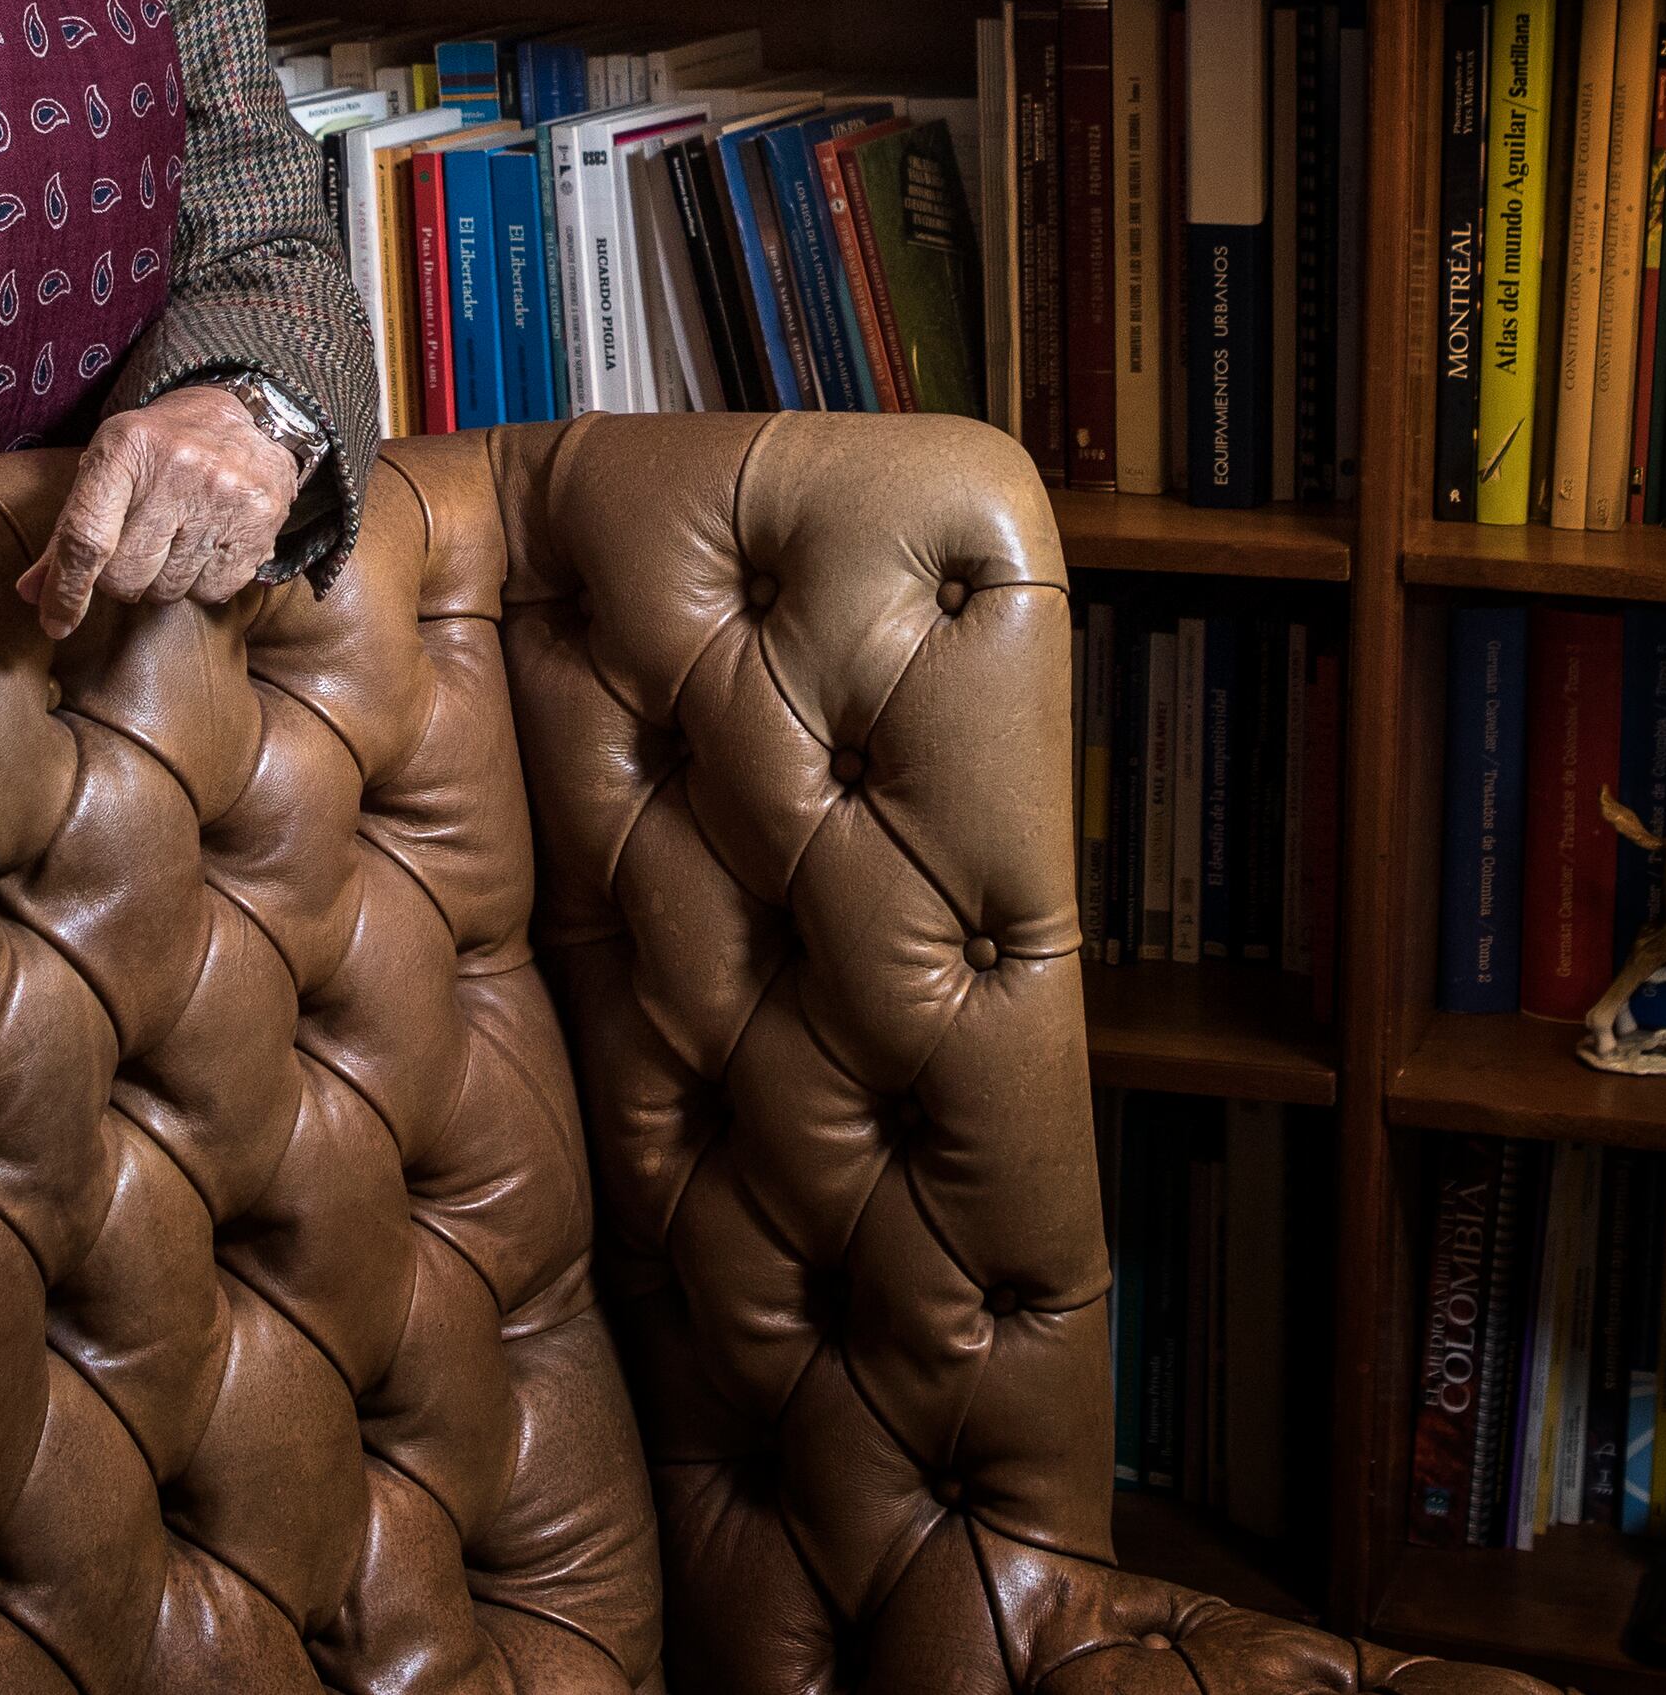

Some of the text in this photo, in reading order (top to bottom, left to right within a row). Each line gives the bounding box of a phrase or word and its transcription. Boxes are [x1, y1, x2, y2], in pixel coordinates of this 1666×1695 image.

[1089, 124, 1102, 195] FRONTERIZA
[1463, 49, 1476, 135] YVES MARCOUX
[459, 217, 475, 233] El
[460, 238, 477, 321] Libertador
[509, 224, 524, 241] El
[510, 246, 529, 329] Libertador
[596, 238, 616, 371] RICARDO PIGLIA
[1446, 222, 1472, 379] MONTRÉAL
[1495, 199, 1523, 375] Atlas del mundo
[1565, 82, 1594, 391] CONSTITUCION POLITICA DE COLOMBIA
[1598, 83, 1628, 393] CONSTITUCION POLITICA DE COLOMBIA
[1213, 244, 1230, 485] EQUIPAMIENTOS URBANOS
[1207, 688, 1231, 886] El de la competitividad
[1477, 640, 1501, 984] Germán Cavelier Tratados de Colombia Tomo 2
[1555, 657, 1581, 977] Germán Cavelier Tratados de Colombia Tomo
[1651, 783, 1666, 800] de
[1424, 1214, 1455, 1406] EL MEDIO AMBIENTE
[1439, 1180, 1489, 1413] COLOMBIA
